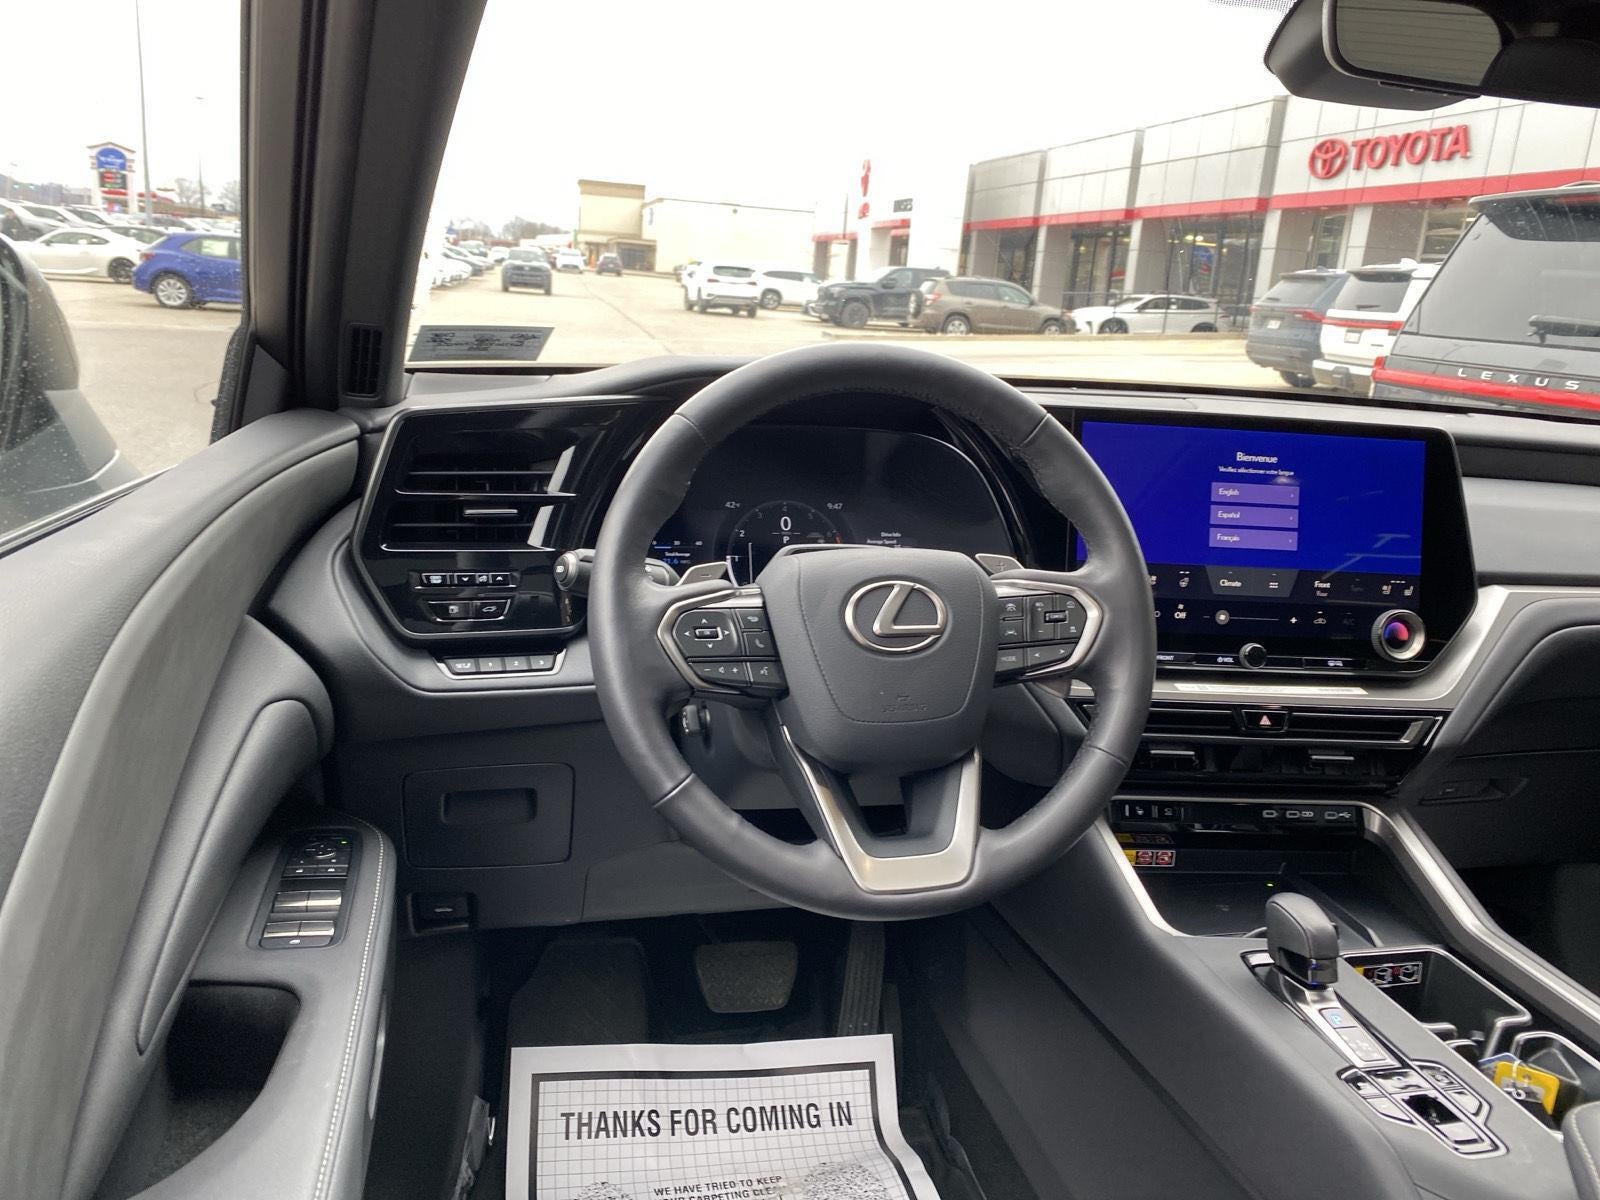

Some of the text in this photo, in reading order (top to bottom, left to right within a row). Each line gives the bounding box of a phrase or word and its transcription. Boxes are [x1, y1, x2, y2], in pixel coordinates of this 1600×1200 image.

[1351, 124, 1470, 170] TOYOTA
[1457, 367, 1580, 391] LEXUS
[1236, 451, 1278, 463] Bienvenue
[1218, 487, 1240, 496] English
[826, 502, 844, 510] 9:47
[1217, 510, 1240, 519] Español
[780, 516, 792, 531] 0
[782, 536, 790, 544] P
[1216, 533, 1240, 542] Français
[1174, 611, 1187, 619] Off
[561, 1100, 853, 1141] THANKS FOR COMING IN
[653, 1175, 782, 1196] WE HAVE TRIED TO KEEP
[687, 1189, 750, 1200] CARPETING
